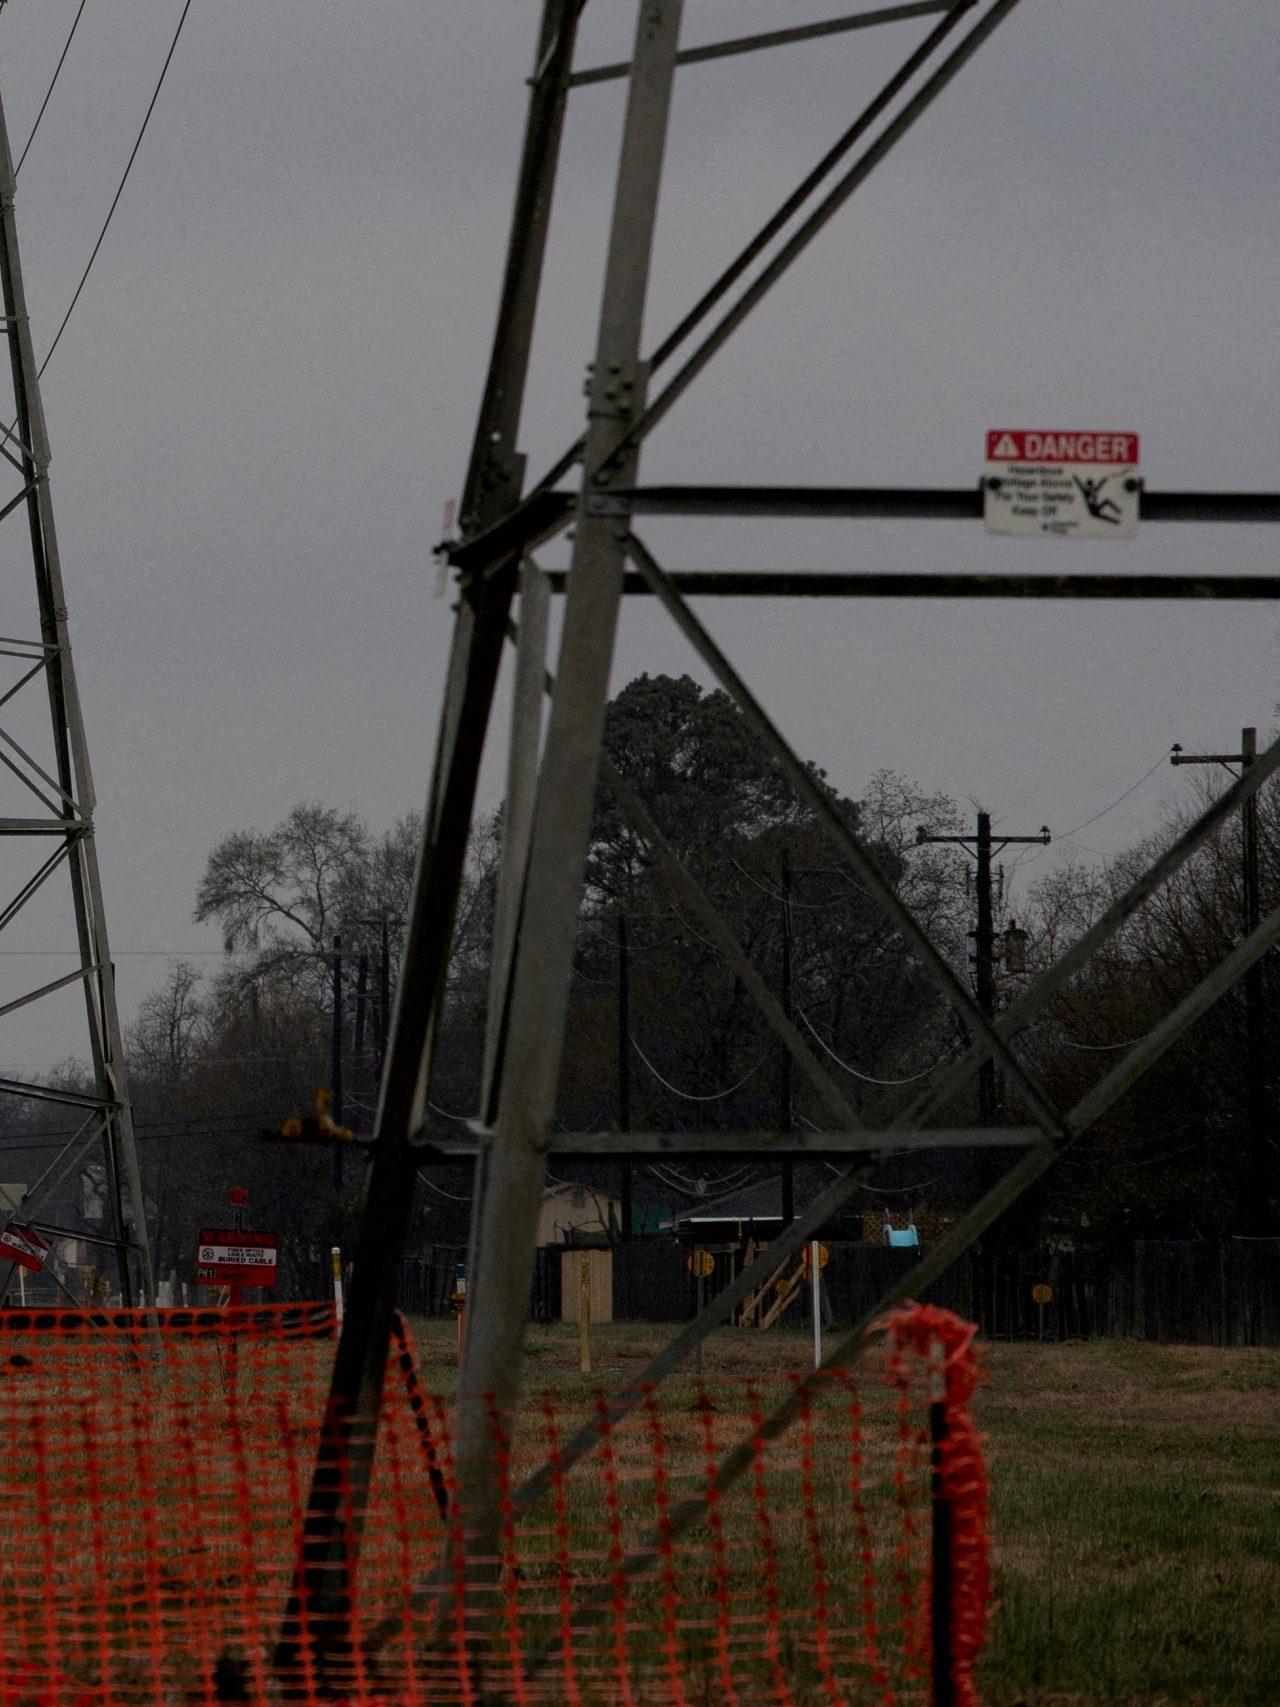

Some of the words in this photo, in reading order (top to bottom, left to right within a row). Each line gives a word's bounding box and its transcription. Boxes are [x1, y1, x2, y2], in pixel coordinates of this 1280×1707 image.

[1025, 434, 1130, 461] DANGER
[202, 1231, 274, 1245] WARNING
[218, 1256, 246, 1264] BURIED
